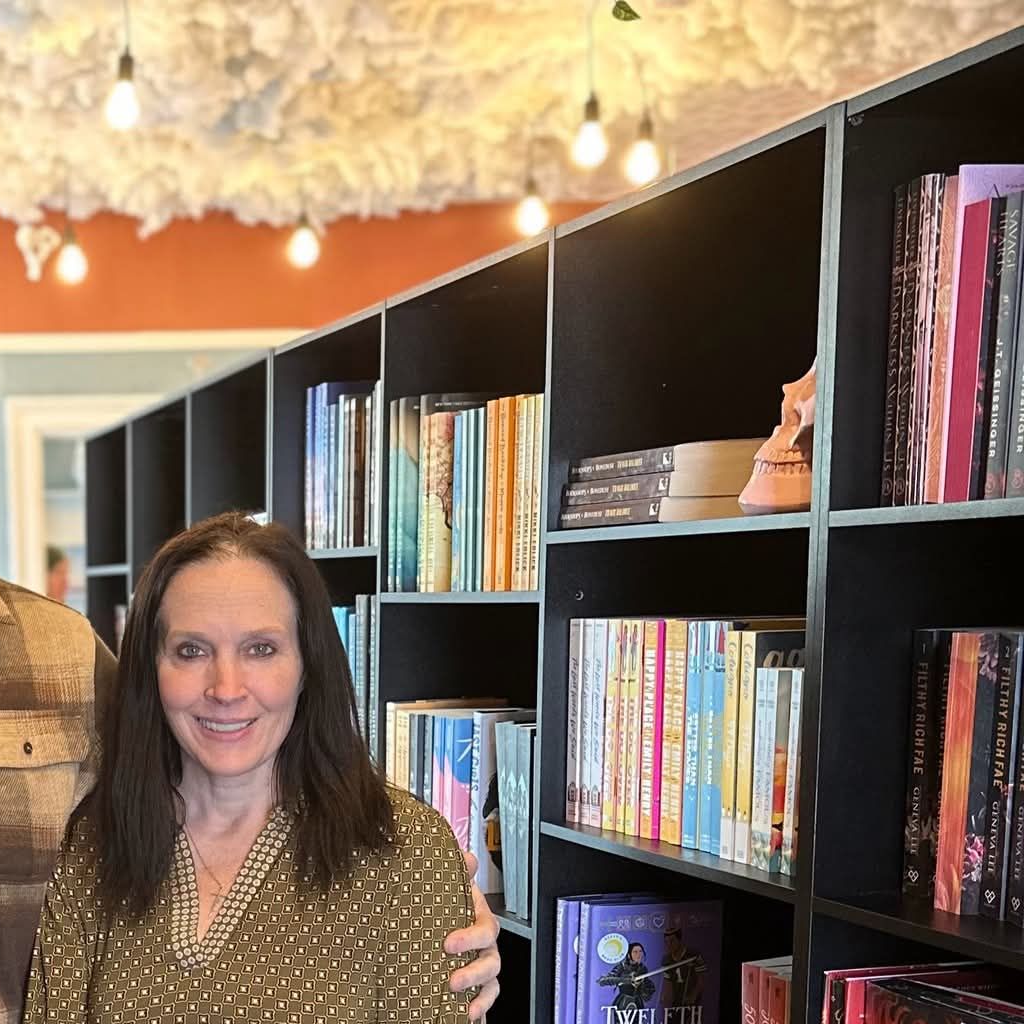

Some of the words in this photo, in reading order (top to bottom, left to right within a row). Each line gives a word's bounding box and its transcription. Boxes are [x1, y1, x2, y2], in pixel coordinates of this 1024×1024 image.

[1005, 209, 1019, 272] SAVAGE
[989, 368, 1001, 457] GEISSINGER
[643, 650, 656, 691] HAPPY
[914, 661, 928, 712] FILTHY
[998, 666, 1012, 717] FILTHY
[642, 694, 655, 729] PLACE
[913, 713, 927, 745] RICH
[996, 720, 1009, 755] RICH
[912, 747, 925, 775] FAE
[992, 756, 1005, 789] FAE
[640, 779, 652, 817] HENRY
[911, 786, 921, 833] GENEVA
[990, 800, 1000, 849] GENEVA
[909, 834, 918, 856] LEE
[987, 851, 996, 874] LEE
[1012, 856, 1023, 880] LEE
